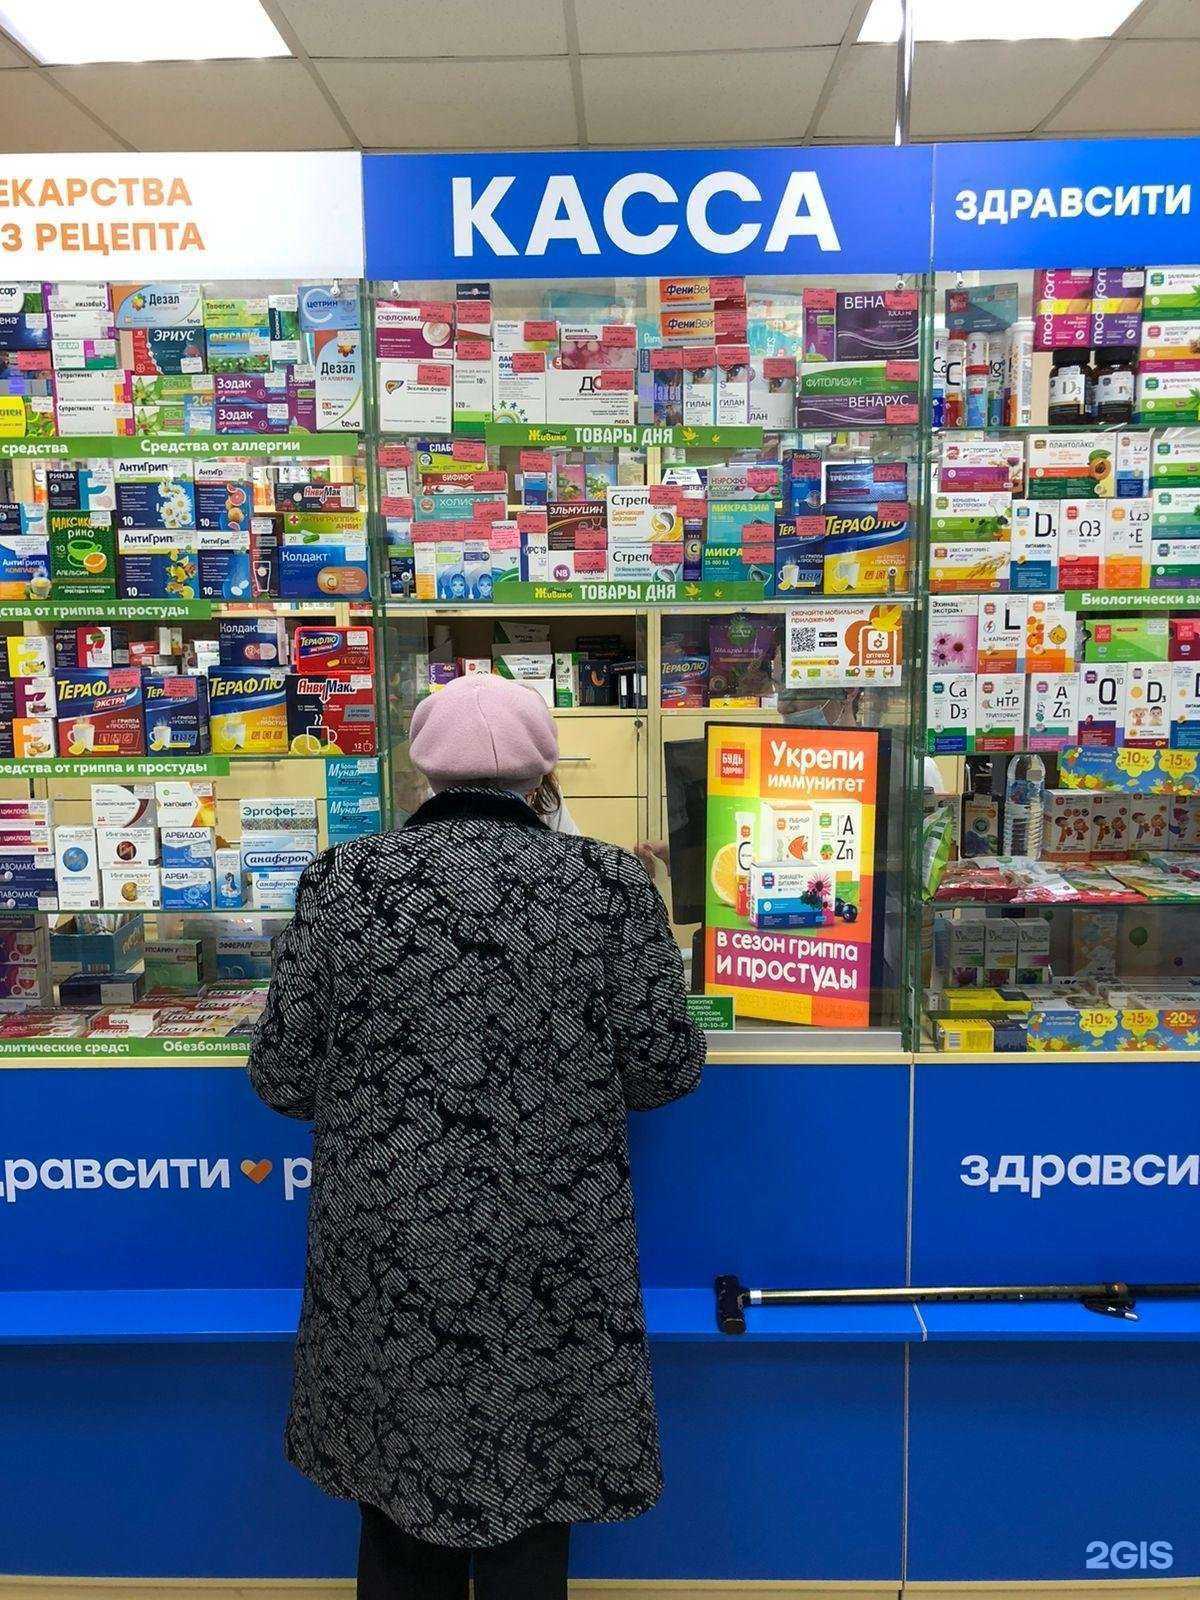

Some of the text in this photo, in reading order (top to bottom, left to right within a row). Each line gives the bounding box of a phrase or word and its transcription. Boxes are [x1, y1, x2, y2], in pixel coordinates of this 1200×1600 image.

[955, 184, 1192, 225] ЗДРАВСИТИ
[450, 171, 842, 257] КАССА
[36, 222, 206, 256] РЕЦЕПТА
[150, 294, 180, 305] Дезал
[844, 296, 885, 310] ВЕНА
[154, 329, 196, 342] ЭРИУС
[320, 362, 356, 375] Дезал
[946, 361, 962, 386] C
[217, 378, 252, 390] Зодак
[805, 377, 863, 388] ФИТОЛИЗИН
[849, 394, 909, 408] ВЕНАРУС
[218, 409, 254, 421] Зодак
[341, 420, 360, 428] teva
[574, 427, 674, 445] ТОВАРЫ ДНЯ
[2, 442, 69, 455] средства
[140, 440, 300, 455] Средства от аллергии
[549, 505, 604, 515] ЭЛЬМУЦИН
[711, 503, 770, 513] МИКРАЗИМ
[122, 516, 134, 527] 10
[200, 518, 210, 527] 10
[1035, 512, 1057, 538] D3
[1079, 520, 1101, 537] Ω3
[282, 550, 328, 564] Колдакт
[705, 547, 743, 557] МИКРА
[126, 586, 138, 598] 10
[203, 586, 213, 595] 10
[579, 584, 677, 601] ТОВАРЫ ДНЯ
[1081, 592, 1184, 607] Биологически
[0, 606, 189, 619] ства от гриппа и простуды
[209, 677, 284, 698] ТЕРАФЛЮ
[949, 681, 968, 698] Ca
[1146, 681, 1167, 703] D3
[95, 697, 127, 711] ЭКСТРА
[950, 703, 968, 719] D3
[1052, 701, 1071, 718] Zn
[722, 752, 743, 764] БУДЬ
[770, 739, 865, 775] Укрепи
[55, 765, 71, 773] от
[74, 764, 123, 775] гриппа
[126, 765, 135, 773] и
[138, 764, 208, 776] простуды
[767, 772, 865, 796] иммунитет
[836, 839, 854, 861] Zn
[250, 852, 309, 867] анаферон
[259, 880, 298, 890] анаферон
[716, 931, 858, 962] в сезон гриппа
[716, 954, 858, 993] и простуды
[1086, 1012, 1113, 1025] -10%
[1165, 1011, 1197, 1024] -20%
[0, 1158, 230, 1202] равсити
[960, 1154, 1200, 1199] здравси
